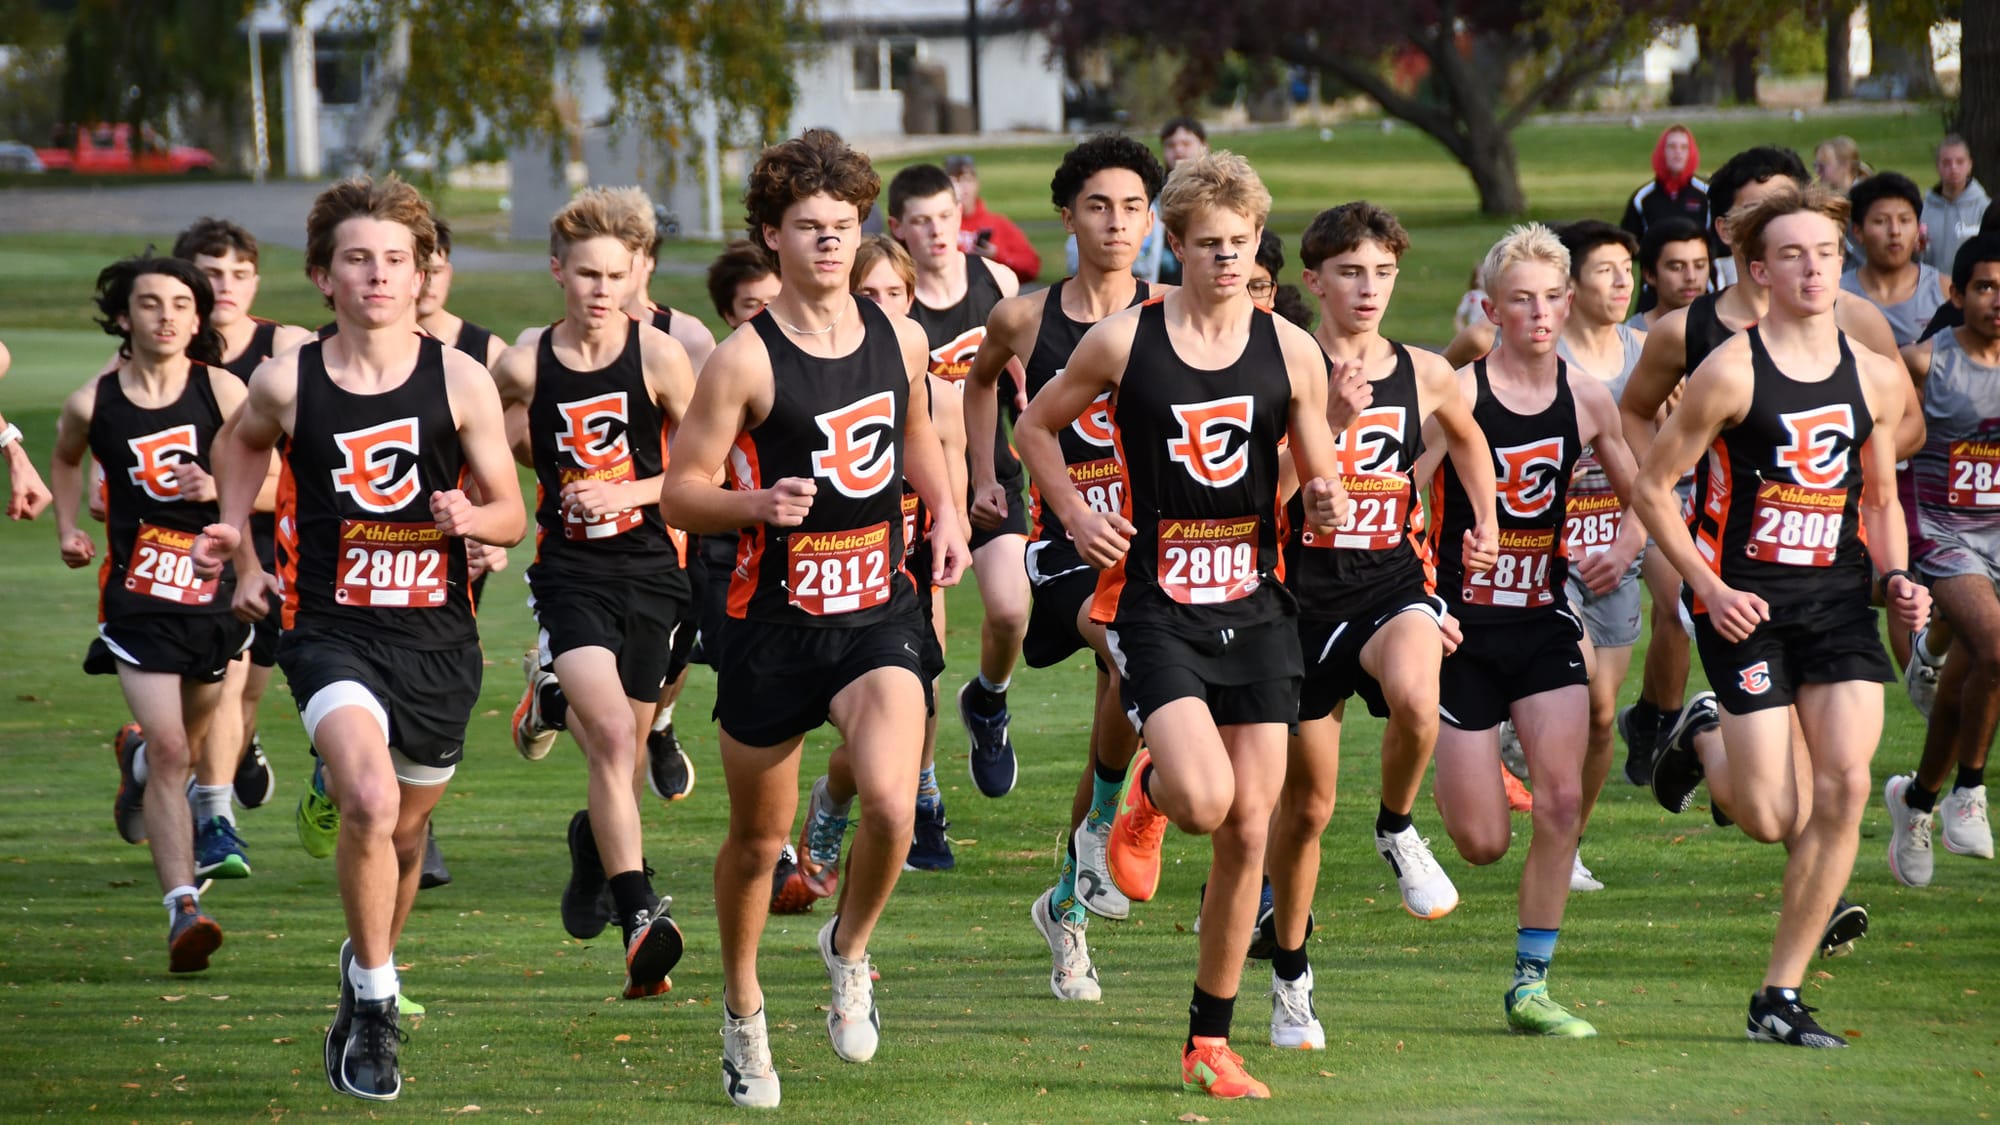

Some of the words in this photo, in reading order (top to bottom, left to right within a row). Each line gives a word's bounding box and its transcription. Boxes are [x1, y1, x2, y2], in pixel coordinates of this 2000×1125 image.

[1336, 498, 1397, 532] 821
[1756, 507, 1843, 548] 2808
[344, 548, 440, 588] 2802
[795, 550, 885, 596] 2812
[1165, 542, 1253, 585] 2809
